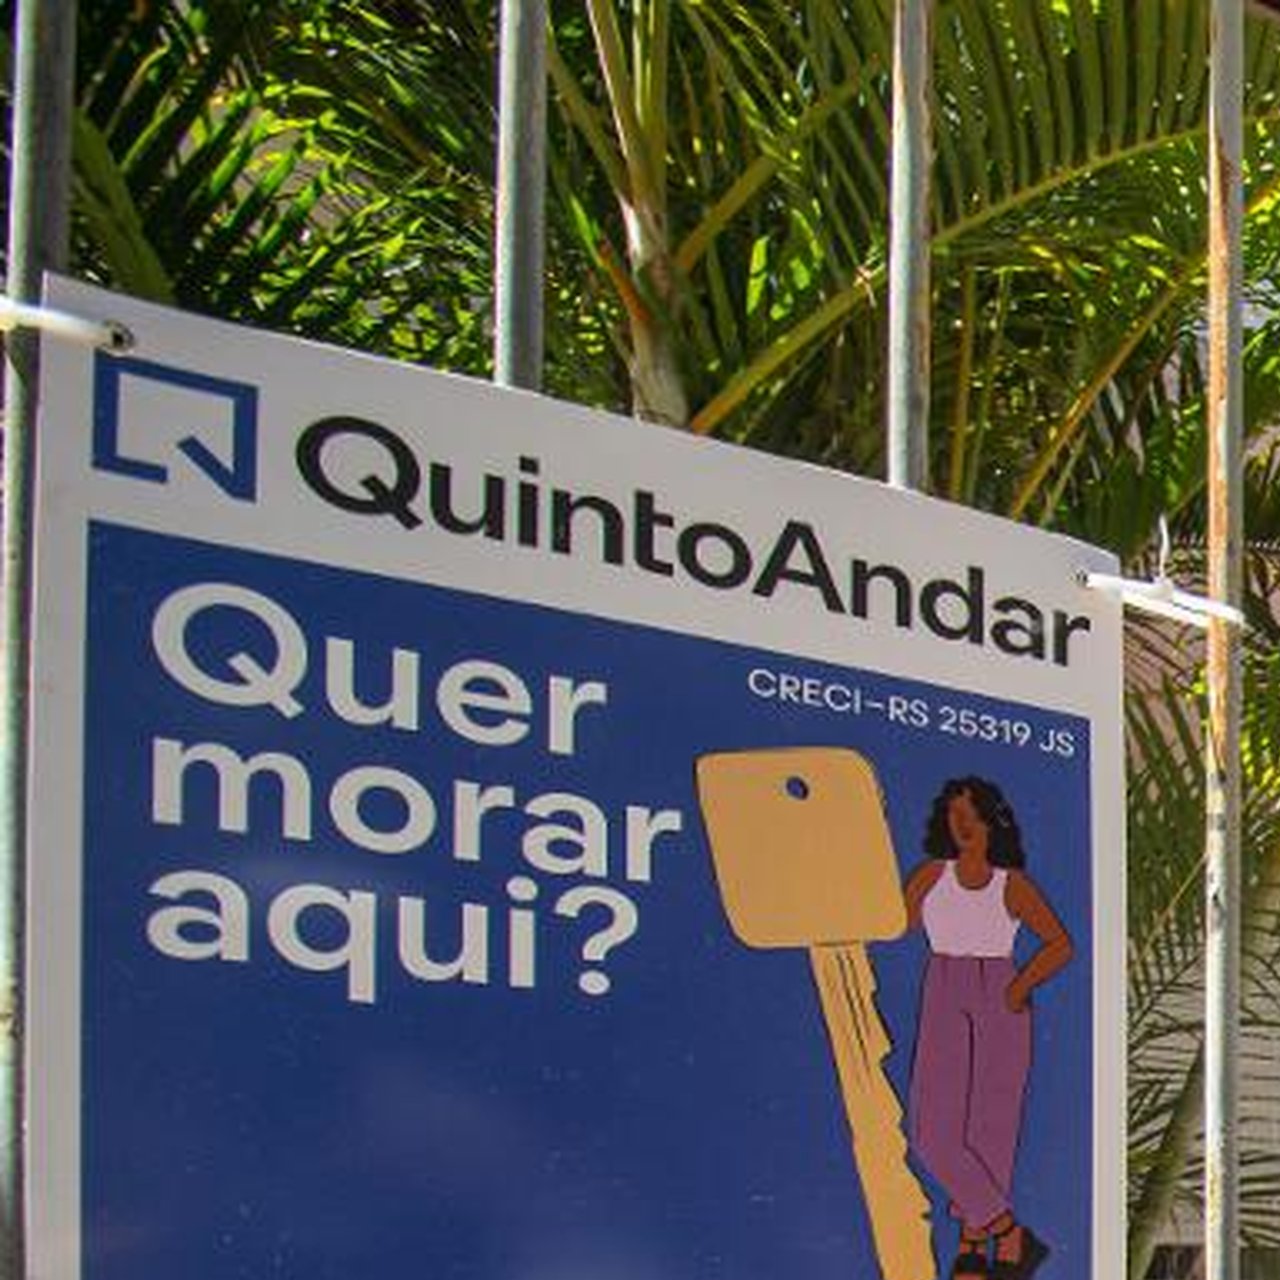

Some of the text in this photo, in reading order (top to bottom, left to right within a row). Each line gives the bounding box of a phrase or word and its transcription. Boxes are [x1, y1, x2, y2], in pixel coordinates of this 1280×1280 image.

[294, 415, 1091, 667] QuintoAndar
[151, 581, 607, 756] Quer
[747, 668, 1076, 757] CRECI-RS 25319 JS
[151, 736, 683, 884] morar
[146, 869, 639, 1005] aqui?
